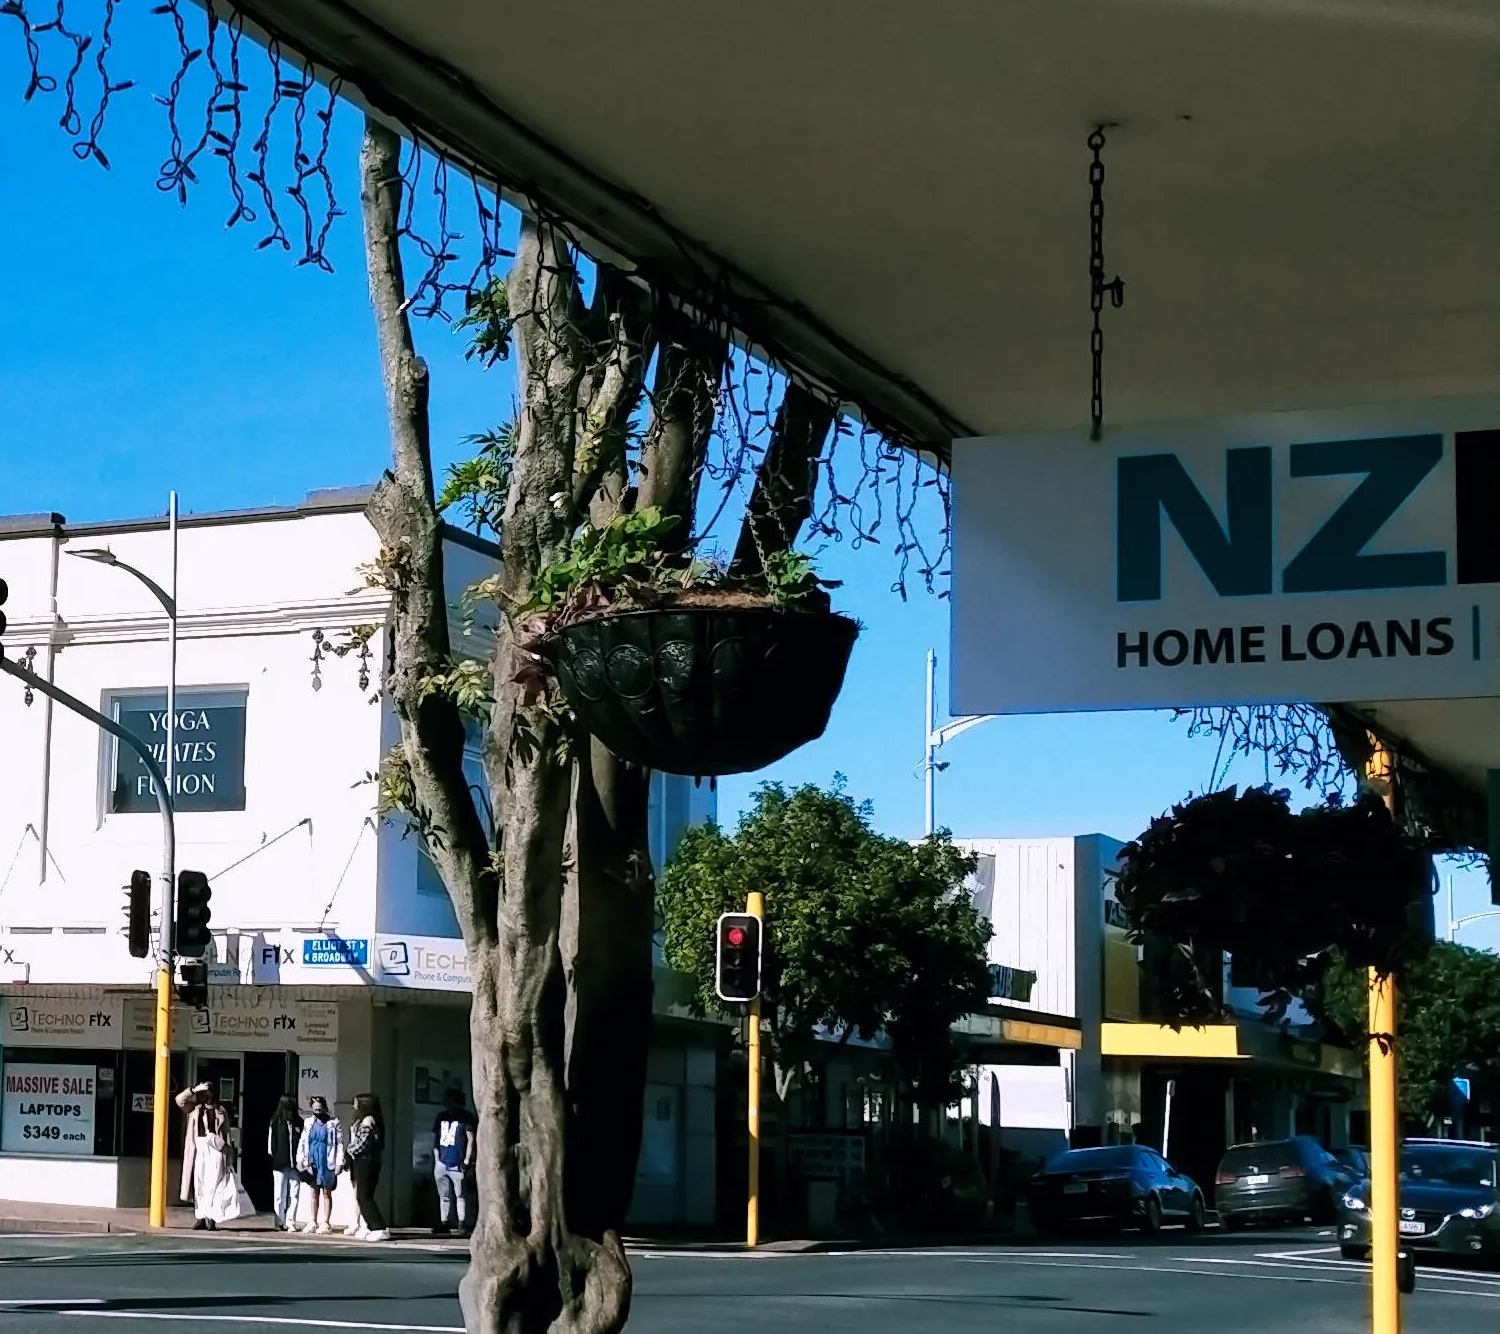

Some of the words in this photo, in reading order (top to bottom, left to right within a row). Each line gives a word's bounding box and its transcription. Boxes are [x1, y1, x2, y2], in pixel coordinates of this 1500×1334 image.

[1116, 625, 1266, 668] HOME
[1281, 617, 1454, 662] LOANS
[149, 710, 211, 732] YOGA
[137, 773, 215, 796] FUION
[263, 943, 295, 965] FIX
[345, 940, 357, 951] ST
[312, 952, 359, 963] BROADWAY
[413, 947, 468, 971] TECH
[414, 971, 436, 980] Phone
[32, 1009, 85, 1026] TECHNO
[89, 1010, 112, 1027] FIX
[212, 1012, 270, 1029] TECHNO
[274, 1013, 296, 1029] FIX
[301, 1067, 319, 1080] FIX
[6, 1075, 59, 1095] MASSIVE
[62, 1077, 94, 1095] SALE
[19, 1103, 81, 1117] LAPTOPS
[22, 1124, 61, 1140] $349
[63, 1133, 86, 1141] each
